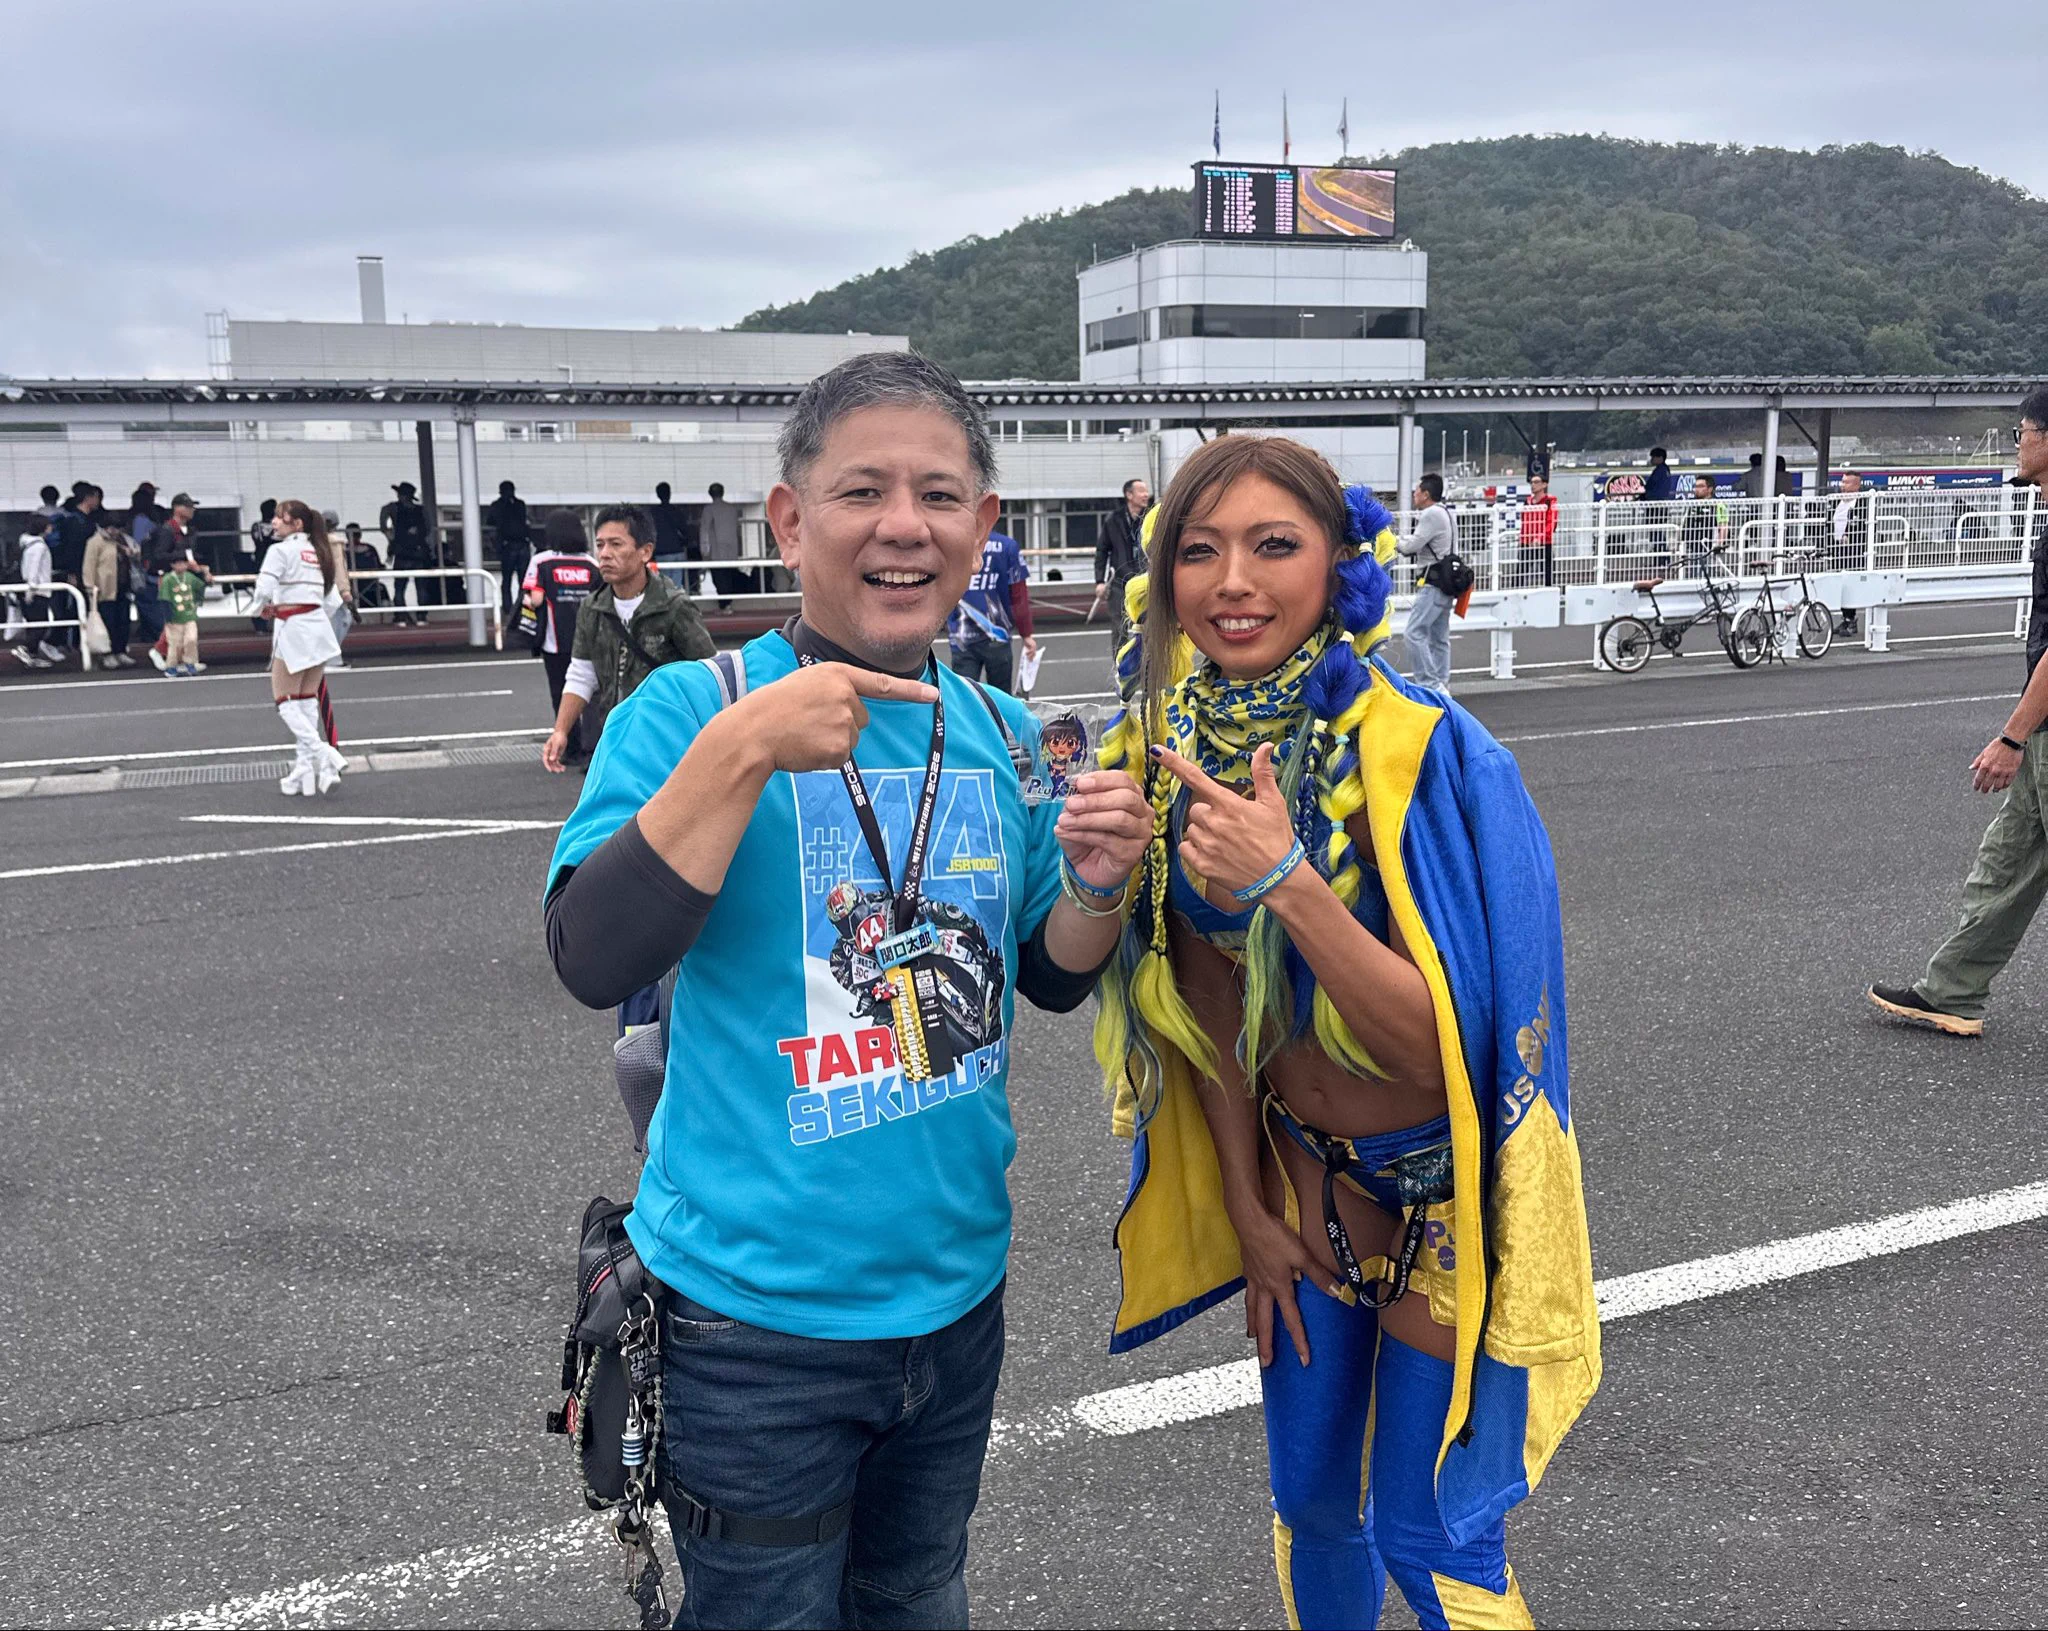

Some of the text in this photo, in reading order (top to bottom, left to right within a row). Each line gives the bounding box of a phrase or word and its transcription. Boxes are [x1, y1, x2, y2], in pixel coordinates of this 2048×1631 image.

[556, 568, 590, 582] TONE
[926, 751, 941, 795] 2026
[946, 857, 998, 873] JSB1000
[859, 917, 884, 951] 44
[880, 931, 933, 965] 関口太郎
[777, 1024, 903, 1088] TAR
[787, 1036, 1006, 1146] SEKIGUCH
